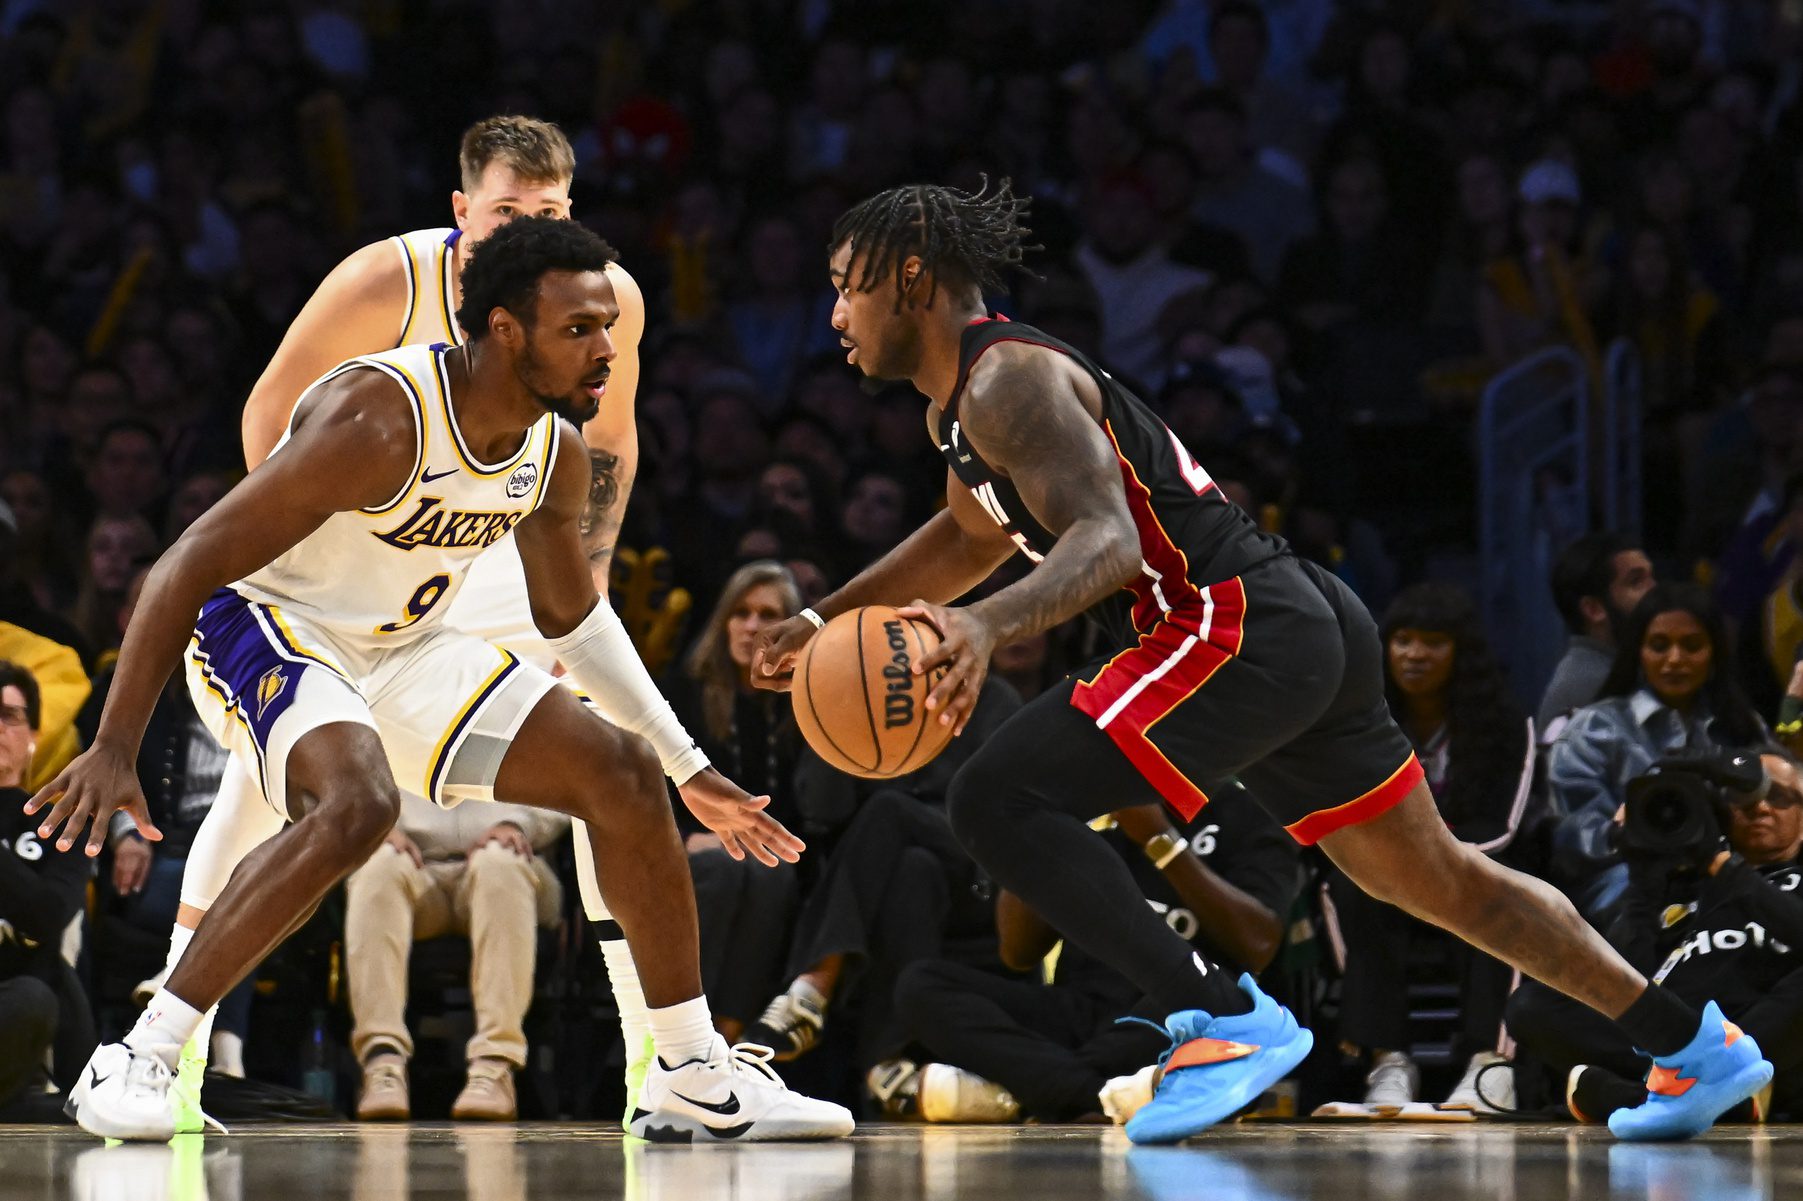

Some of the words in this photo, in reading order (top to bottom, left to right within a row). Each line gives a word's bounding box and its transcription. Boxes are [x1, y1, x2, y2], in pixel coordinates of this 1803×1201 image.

[510, 472, 535, 487] bibigo
[369, 494, 524, 551] LAKERS
[373, 572, 451, 634] 9
[883, 620, 914, 730] Wilson
[15, 831, 43, 860] 6
[1191, 824, 1220, 855] 6
